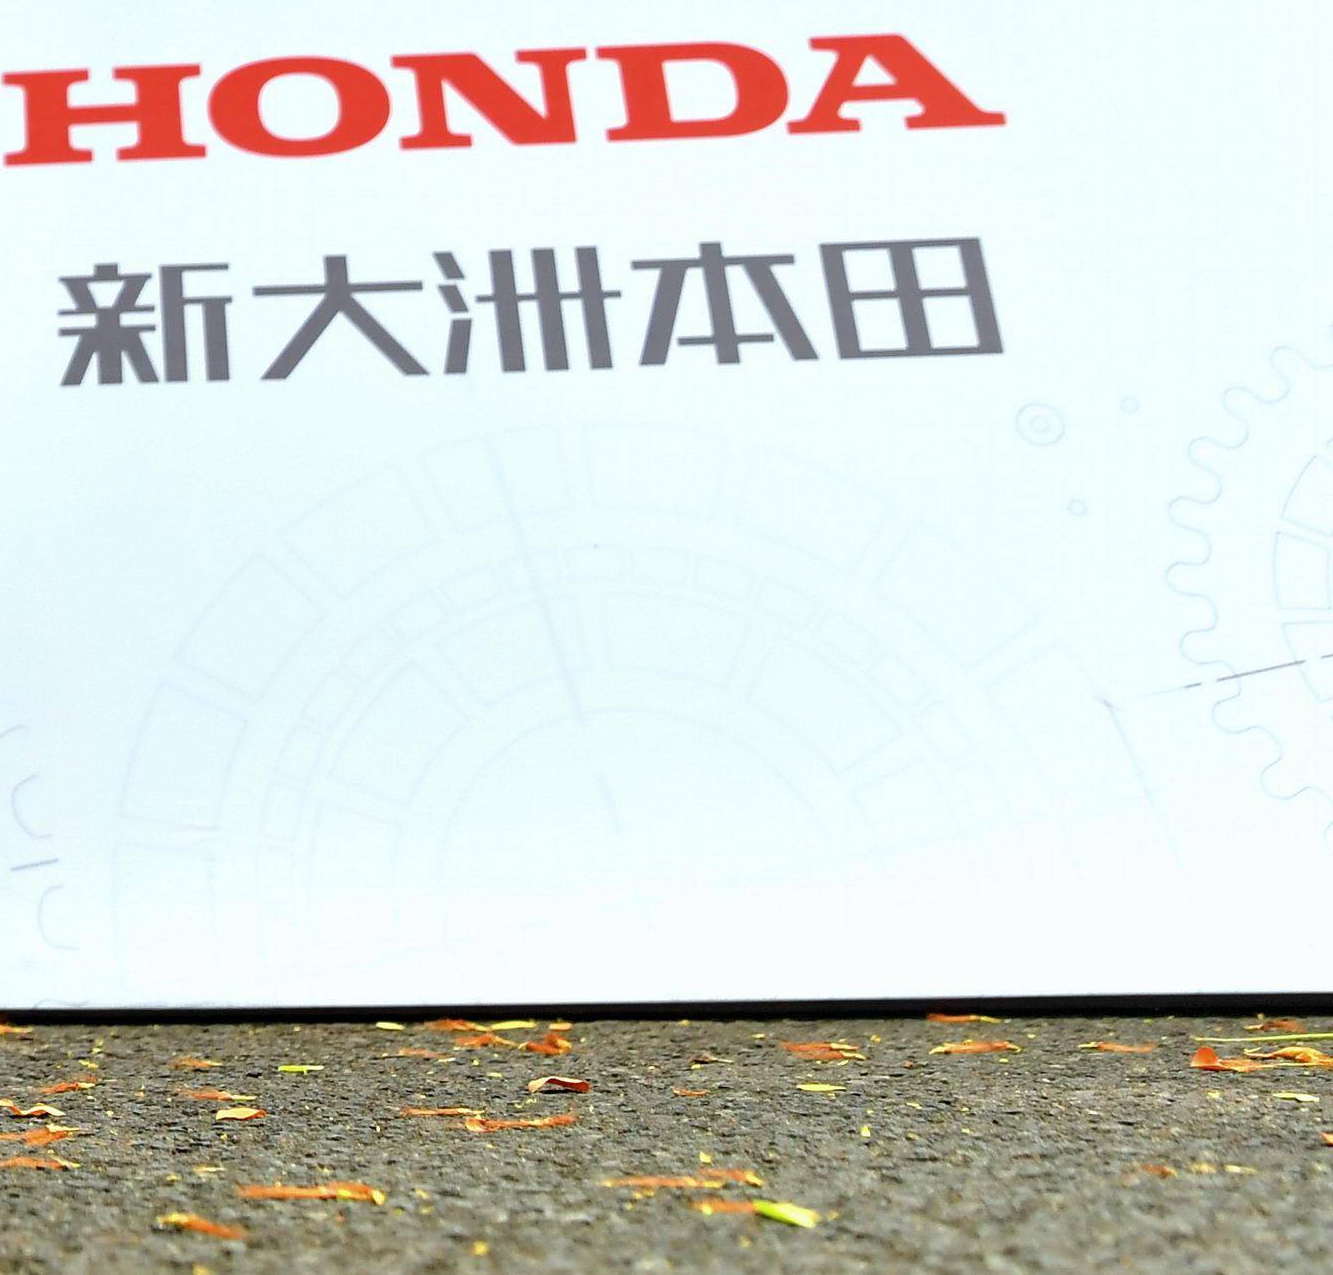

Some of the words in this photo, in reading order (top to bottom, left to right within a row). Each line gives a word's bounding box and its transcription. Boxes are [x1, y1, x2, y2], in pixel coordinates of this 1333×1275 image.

[4, 35, 1005, 165] HONDA
[59, 238, 1003, 386] 新大洲本田
